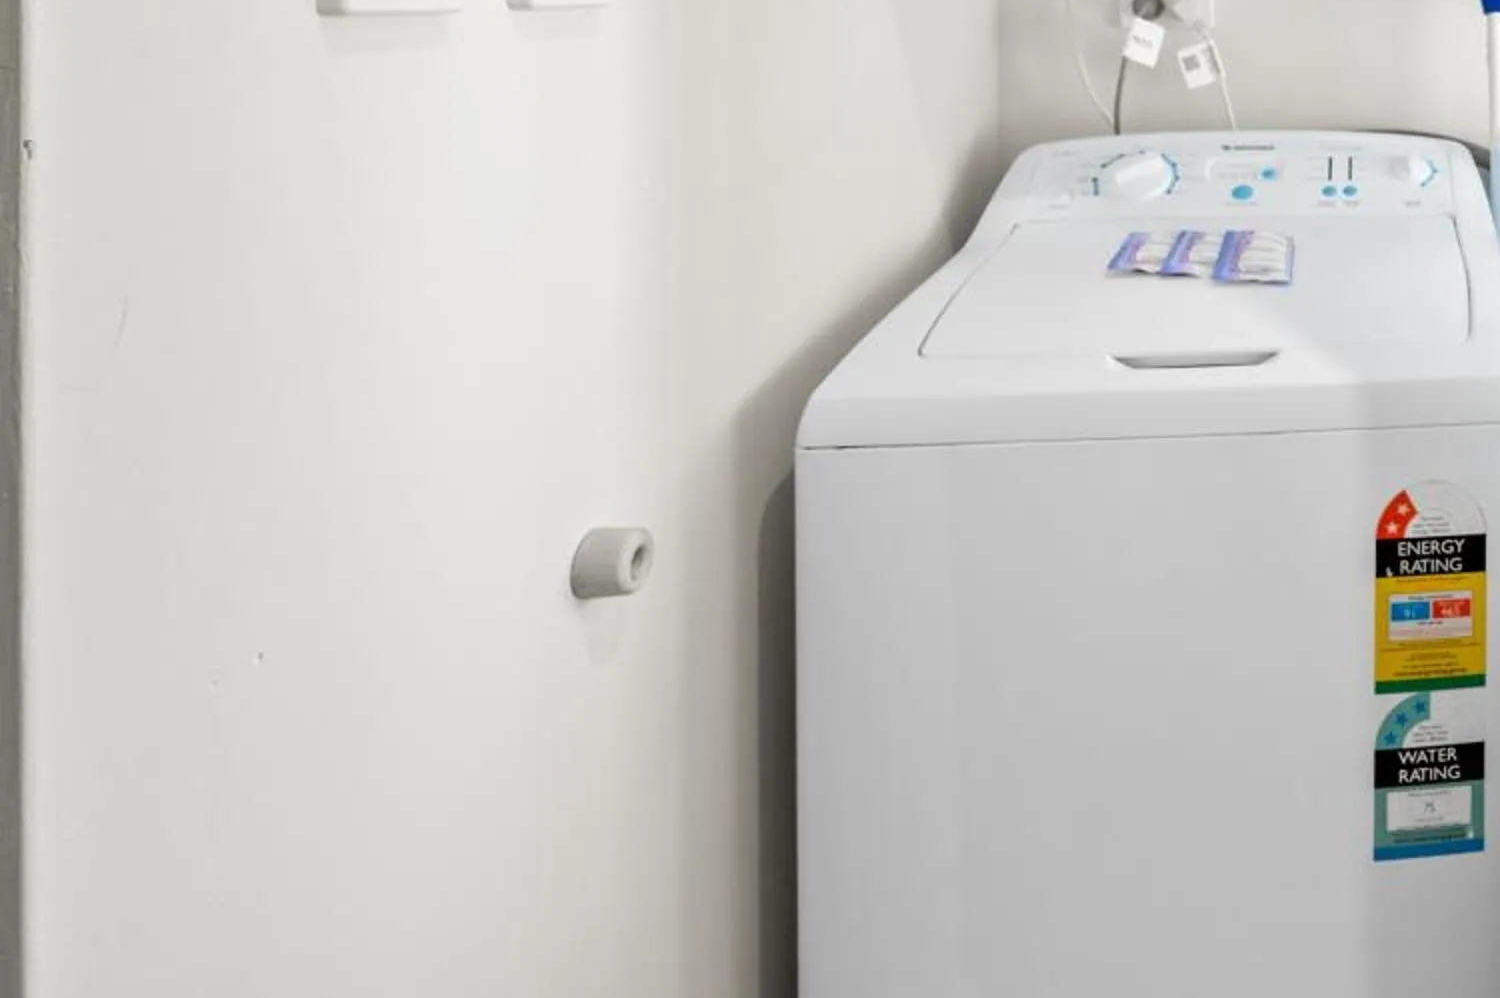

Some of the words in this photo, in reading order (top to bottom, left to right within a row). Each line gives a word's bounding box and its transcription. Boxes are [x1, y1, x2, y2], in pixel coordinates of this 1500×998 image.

[1397, 538, 1466, 557] ENERGY
[1399, 557, 1463, 575] RATING
[1398, 747, 1458, 765] WATER
[1398, 765, 1461, 783] RATING
